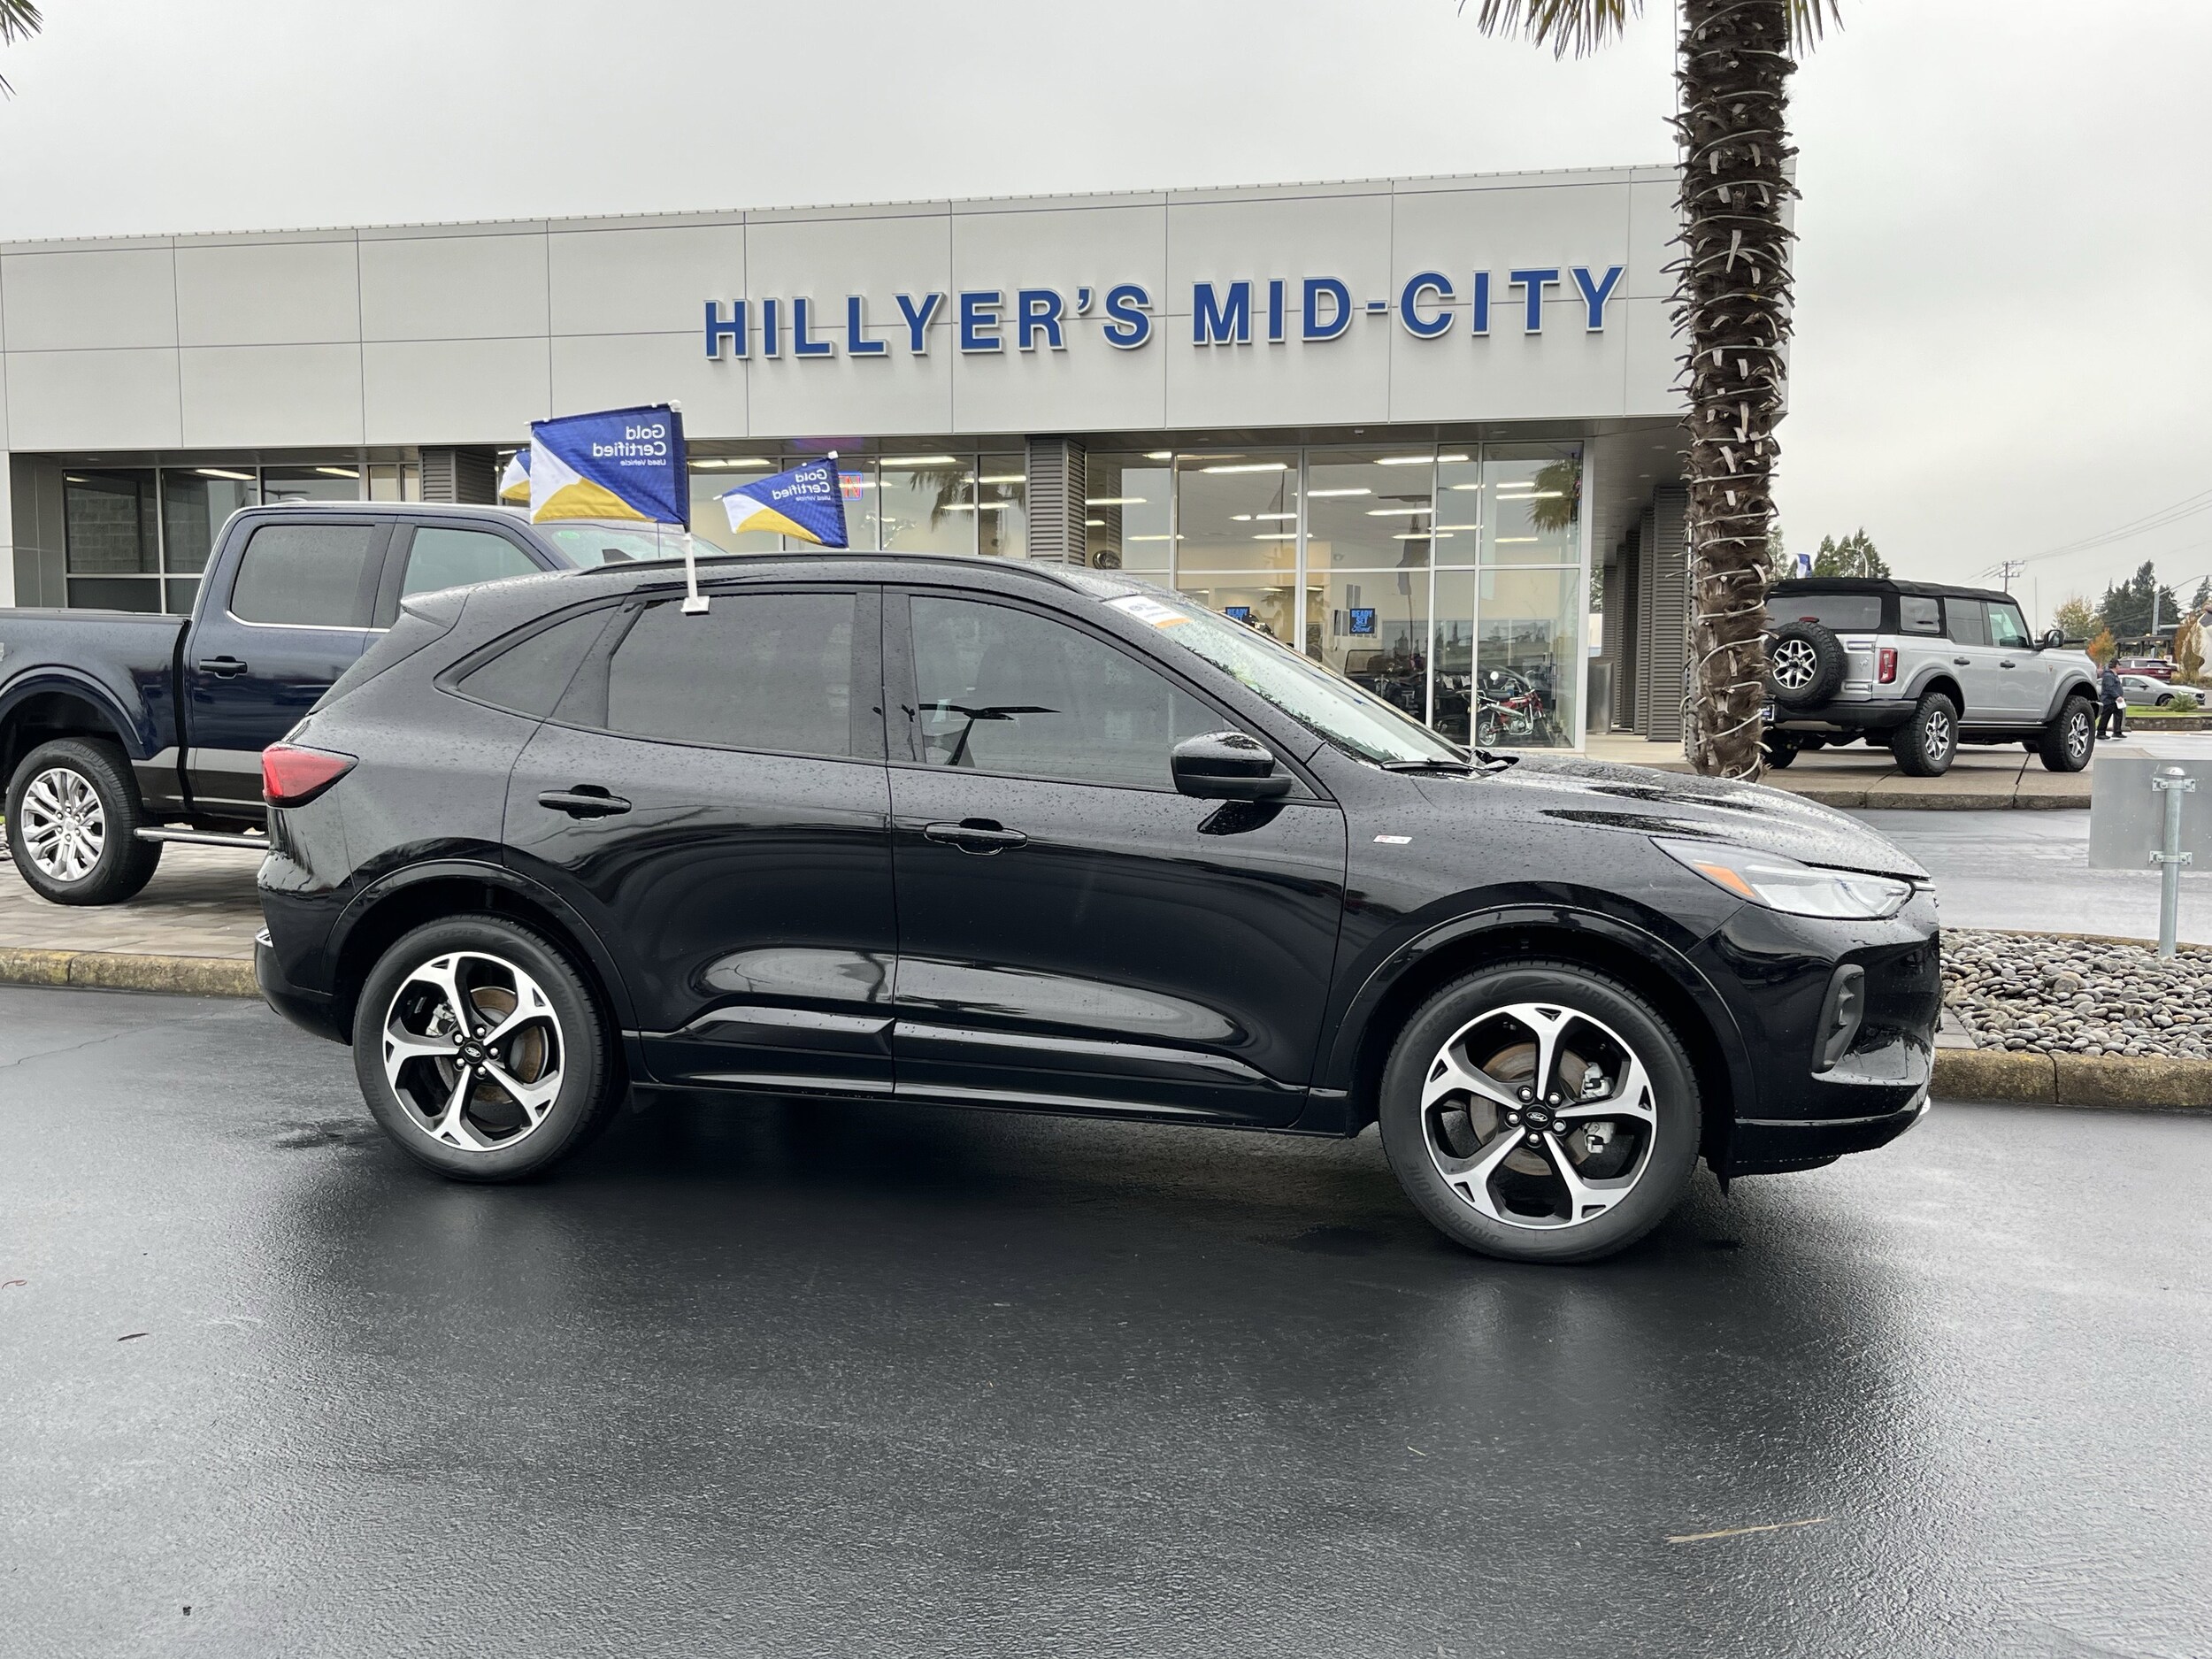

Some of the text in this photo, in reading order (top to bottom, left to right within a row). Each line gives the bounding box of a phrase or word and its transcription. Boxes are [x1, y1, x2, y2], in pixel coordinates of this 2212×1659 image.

[703, 265, 1626, 359] HILLYER'S MID-CITY
[1351, 624, 1371, 633] Ford
